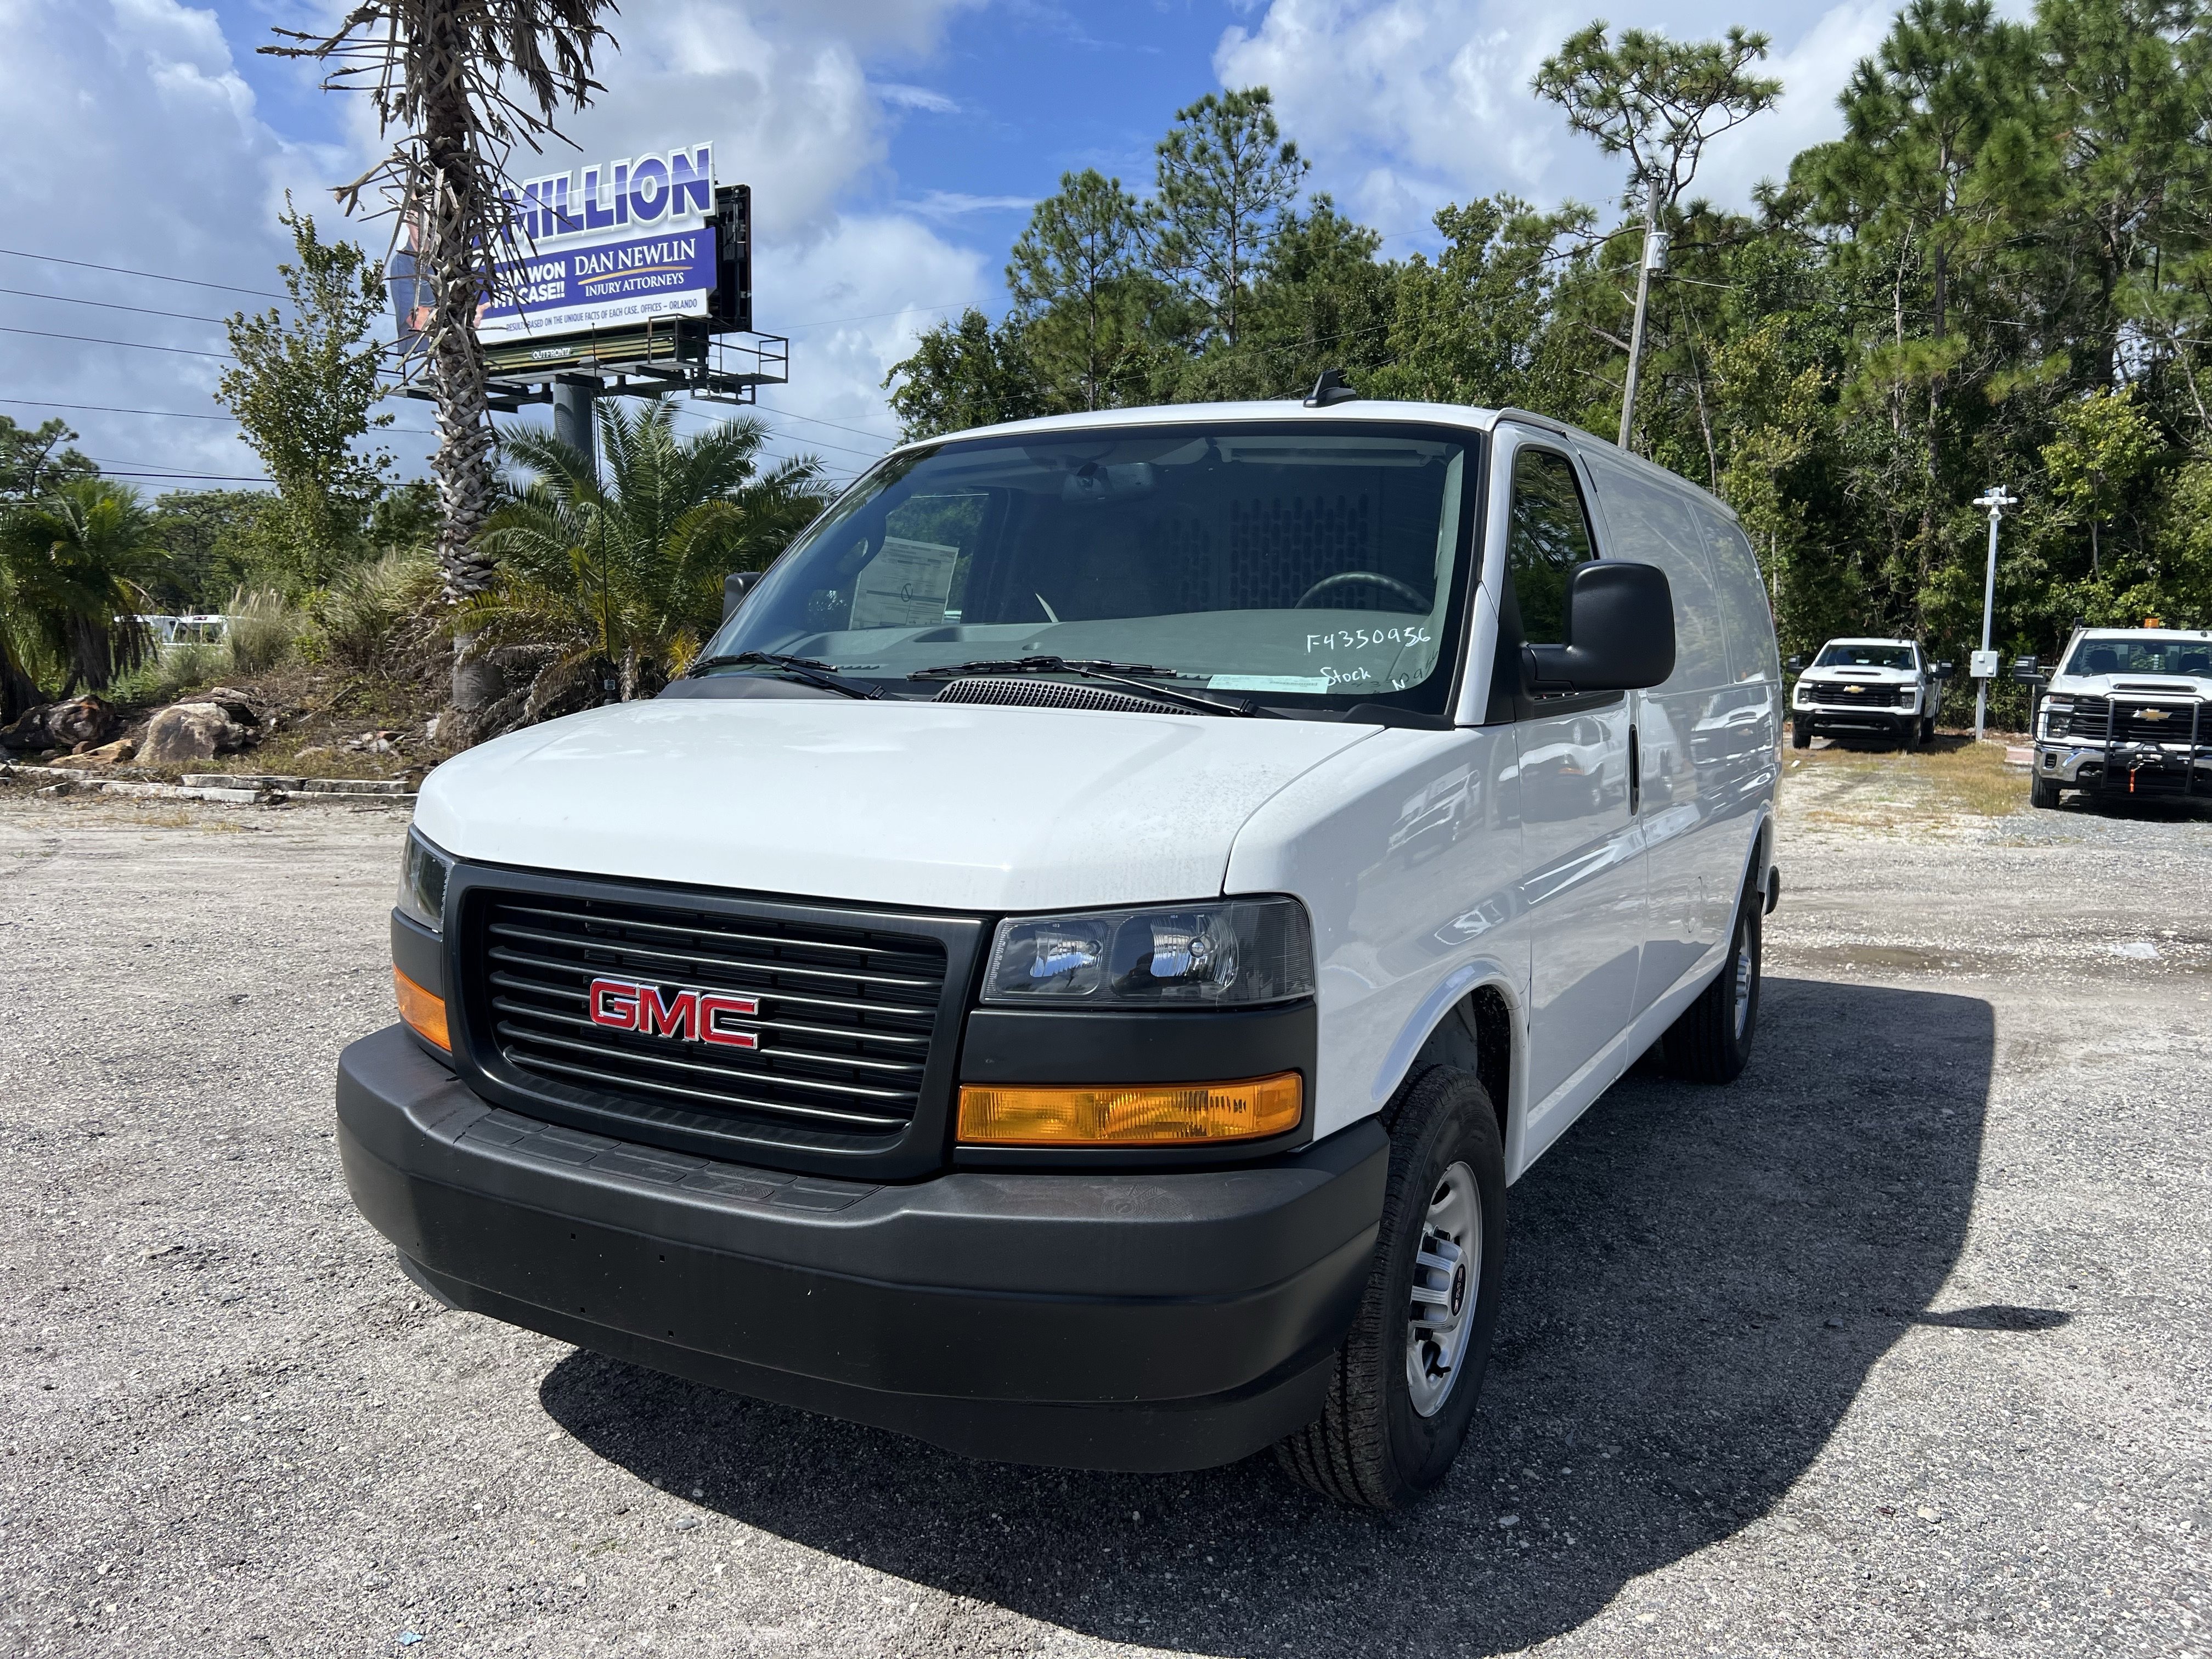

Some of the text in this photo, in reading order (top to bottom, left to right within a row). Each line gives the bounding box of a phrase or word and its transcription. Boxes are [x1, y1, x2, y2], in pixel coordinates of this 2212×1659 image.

[498, 141, 714, 247] MILLION
[574, 238, 696, 276] DAN NEWLIN
[527, 261, 566, 284] WON
[585, 272, 684, 297] INJURY ATTORNEYS
[493, 280, 566, 308] MY CASE!!
[527, 319, 544, 329] BASED
[545, 317, 552, 326] ON
[554, 315, 563, 325] THE
[564, 312, 584, 323] UNIQUE
[585, 311, 600, 320] FACTS
[601, 310, 608, 319] OF
[609, 307, 623, 318] EACH
[641, 302, 662, 313] OFFICES
[669, 298, 697, 310] ORLANDO
[1306, 627, 1431, 653] F4350956
[1320, 667, 1371, 686] Stock
[590, 978, 760, 1050] GMC
